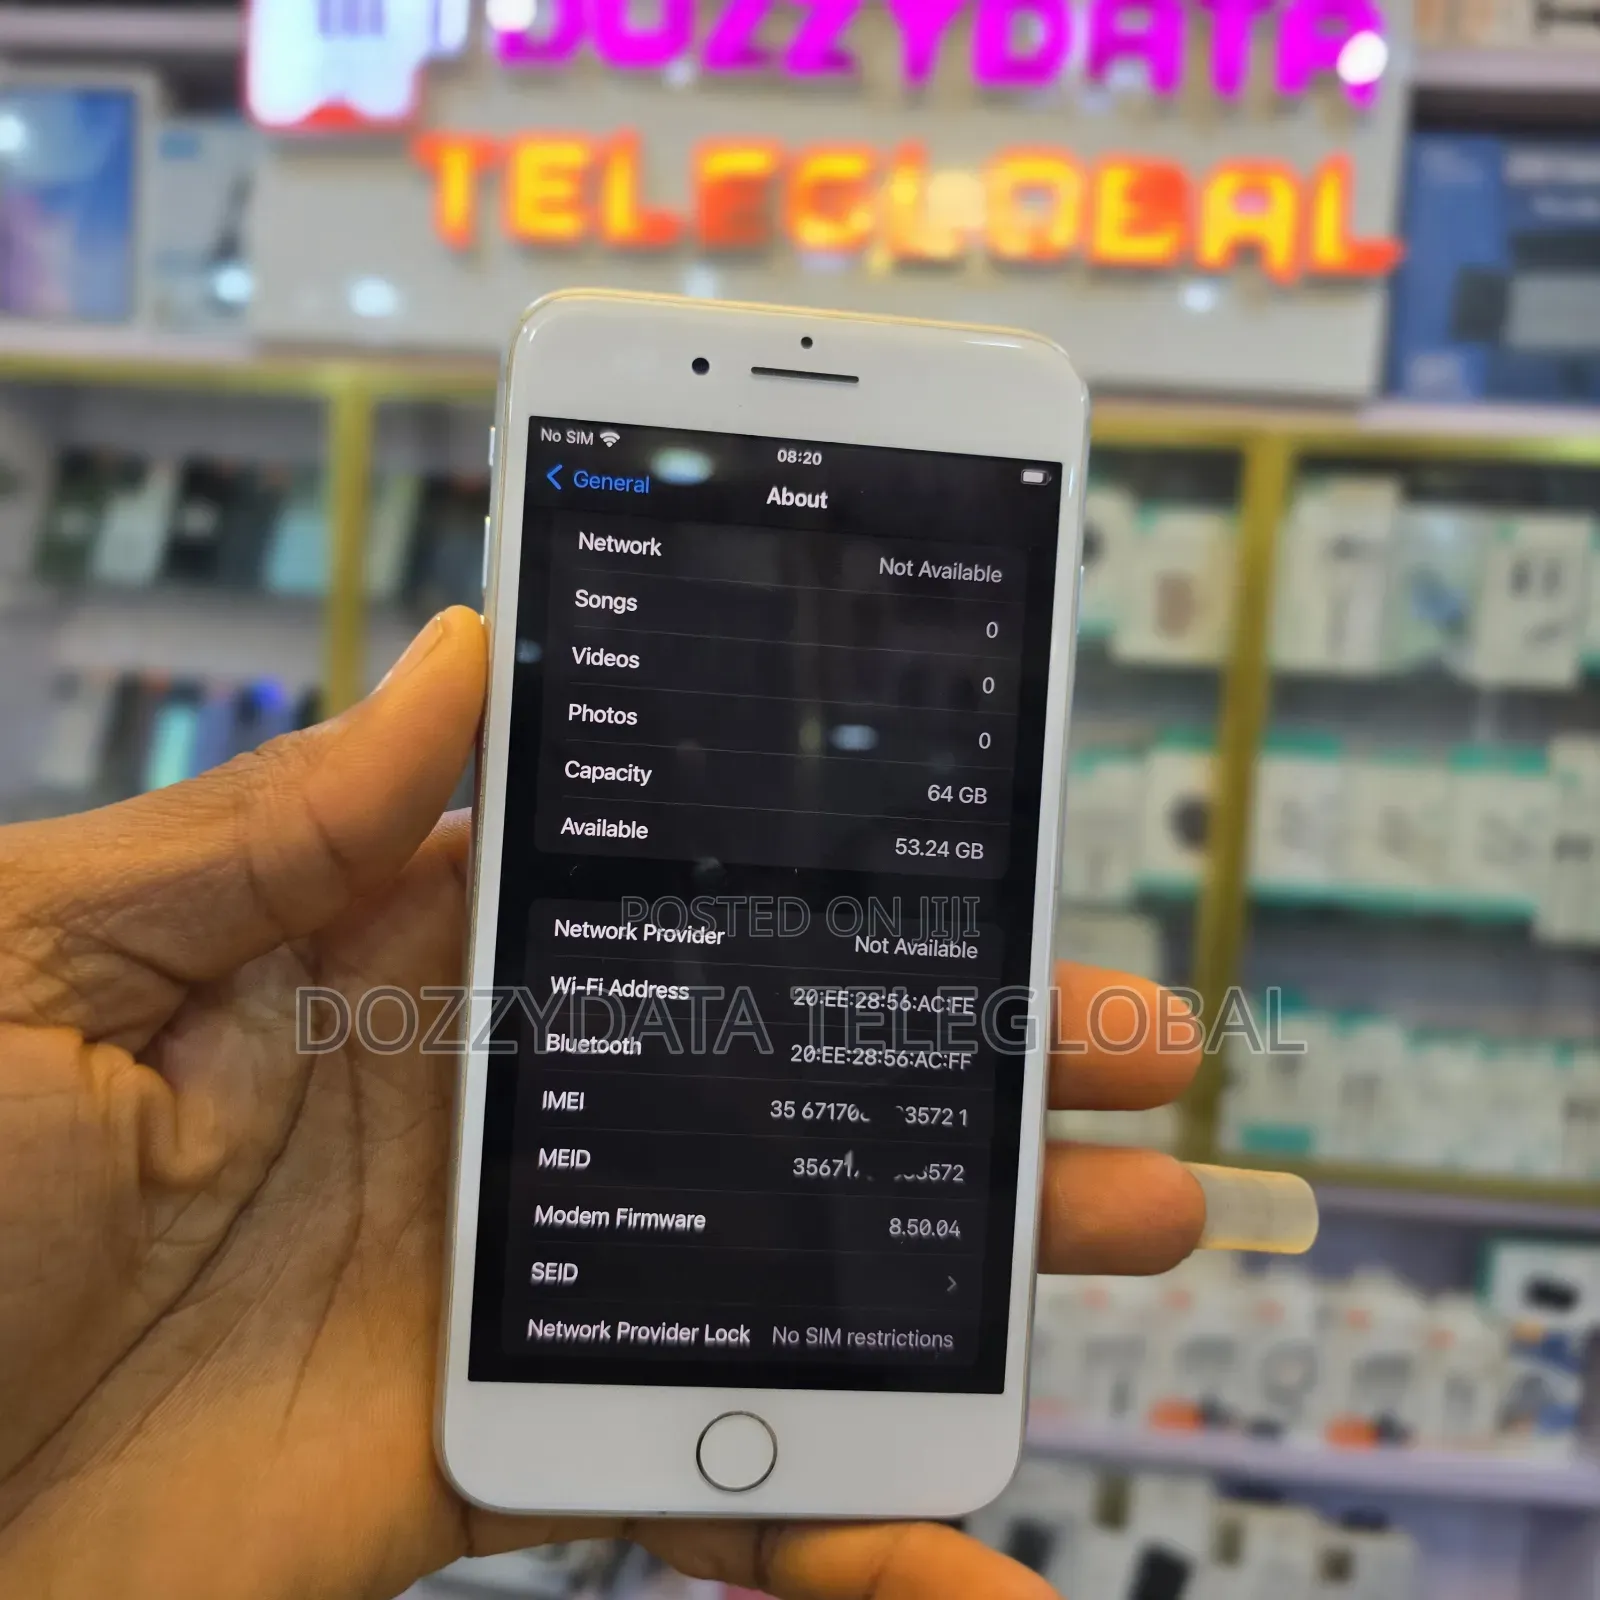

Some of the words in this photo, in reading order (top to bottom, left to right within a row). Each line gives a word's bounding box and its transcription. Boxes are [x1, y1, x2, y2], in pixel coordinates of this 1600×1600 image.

[411, 128, 1404, 282] TELEGLOBAL
[540, 428, 562, 443] No
[566, 430, 594, 446] SIM
[777, 449, 822, 466] 08:20
[573, 469, 650, 494] General
[766, 486, 828, 509] About
[578, 531, 662, 556] Network
[879, 557, 914, 577] Not
[918, 560, 1003, 583] Available
[575, 589, 638, 614] Songs
[985, 621, 998, 639] 0
[572, 646, 640, 669] Videos
[982, 676, 995, 694] 0
[568, 704, 638, 725] Photos
[978, 732, 992, 749] 0
[564, 760, 652, 786] Capacity
[927, 784, 953, 803] 64
[958, 786, 988, 804] GB
[560, 817, 649, 840] Available
[895, 838, 950, 858] 53.24
[955, 841, 984, 860] GB
[554, 919, 638, 941] Network
[643, 923, 725, 945] Provider
[855, 935, 889, 954] Not
[894, 938, 978, 959] Available
[550, 976, 604, 996] Wi-Fi
[608, 979, 690, 1000] Address
[793, 988, 975, 1014] 20:EE:28:56:AC:FE
[546, 1033, 642, 1056] Bluetooth
[790, 1044, 972, 1070] 20:EE:28:56:AC:FF
[542, 1090, 585, 1112] IMEI
[770, 1100, 796, 1120] 35
[538, 1148, 591, 1170] MEID
[534, 1204, 610, 1228] Modem
[616, 1207, 706, 1232] Firmware
[889, 1218, 962, 1238] 8.50.04
[530, 1261, 579, 1285] SEID
[527, 1318, 612, 1341] Network
[617, 1321, 700, 1345] Provider
[704, 1324, 751, 1346] Lock
[772, 1325, 800, 1345] No
[805, 1326, 842, 1346] SIM
[847, 1328, 955, 1349] restrictions
